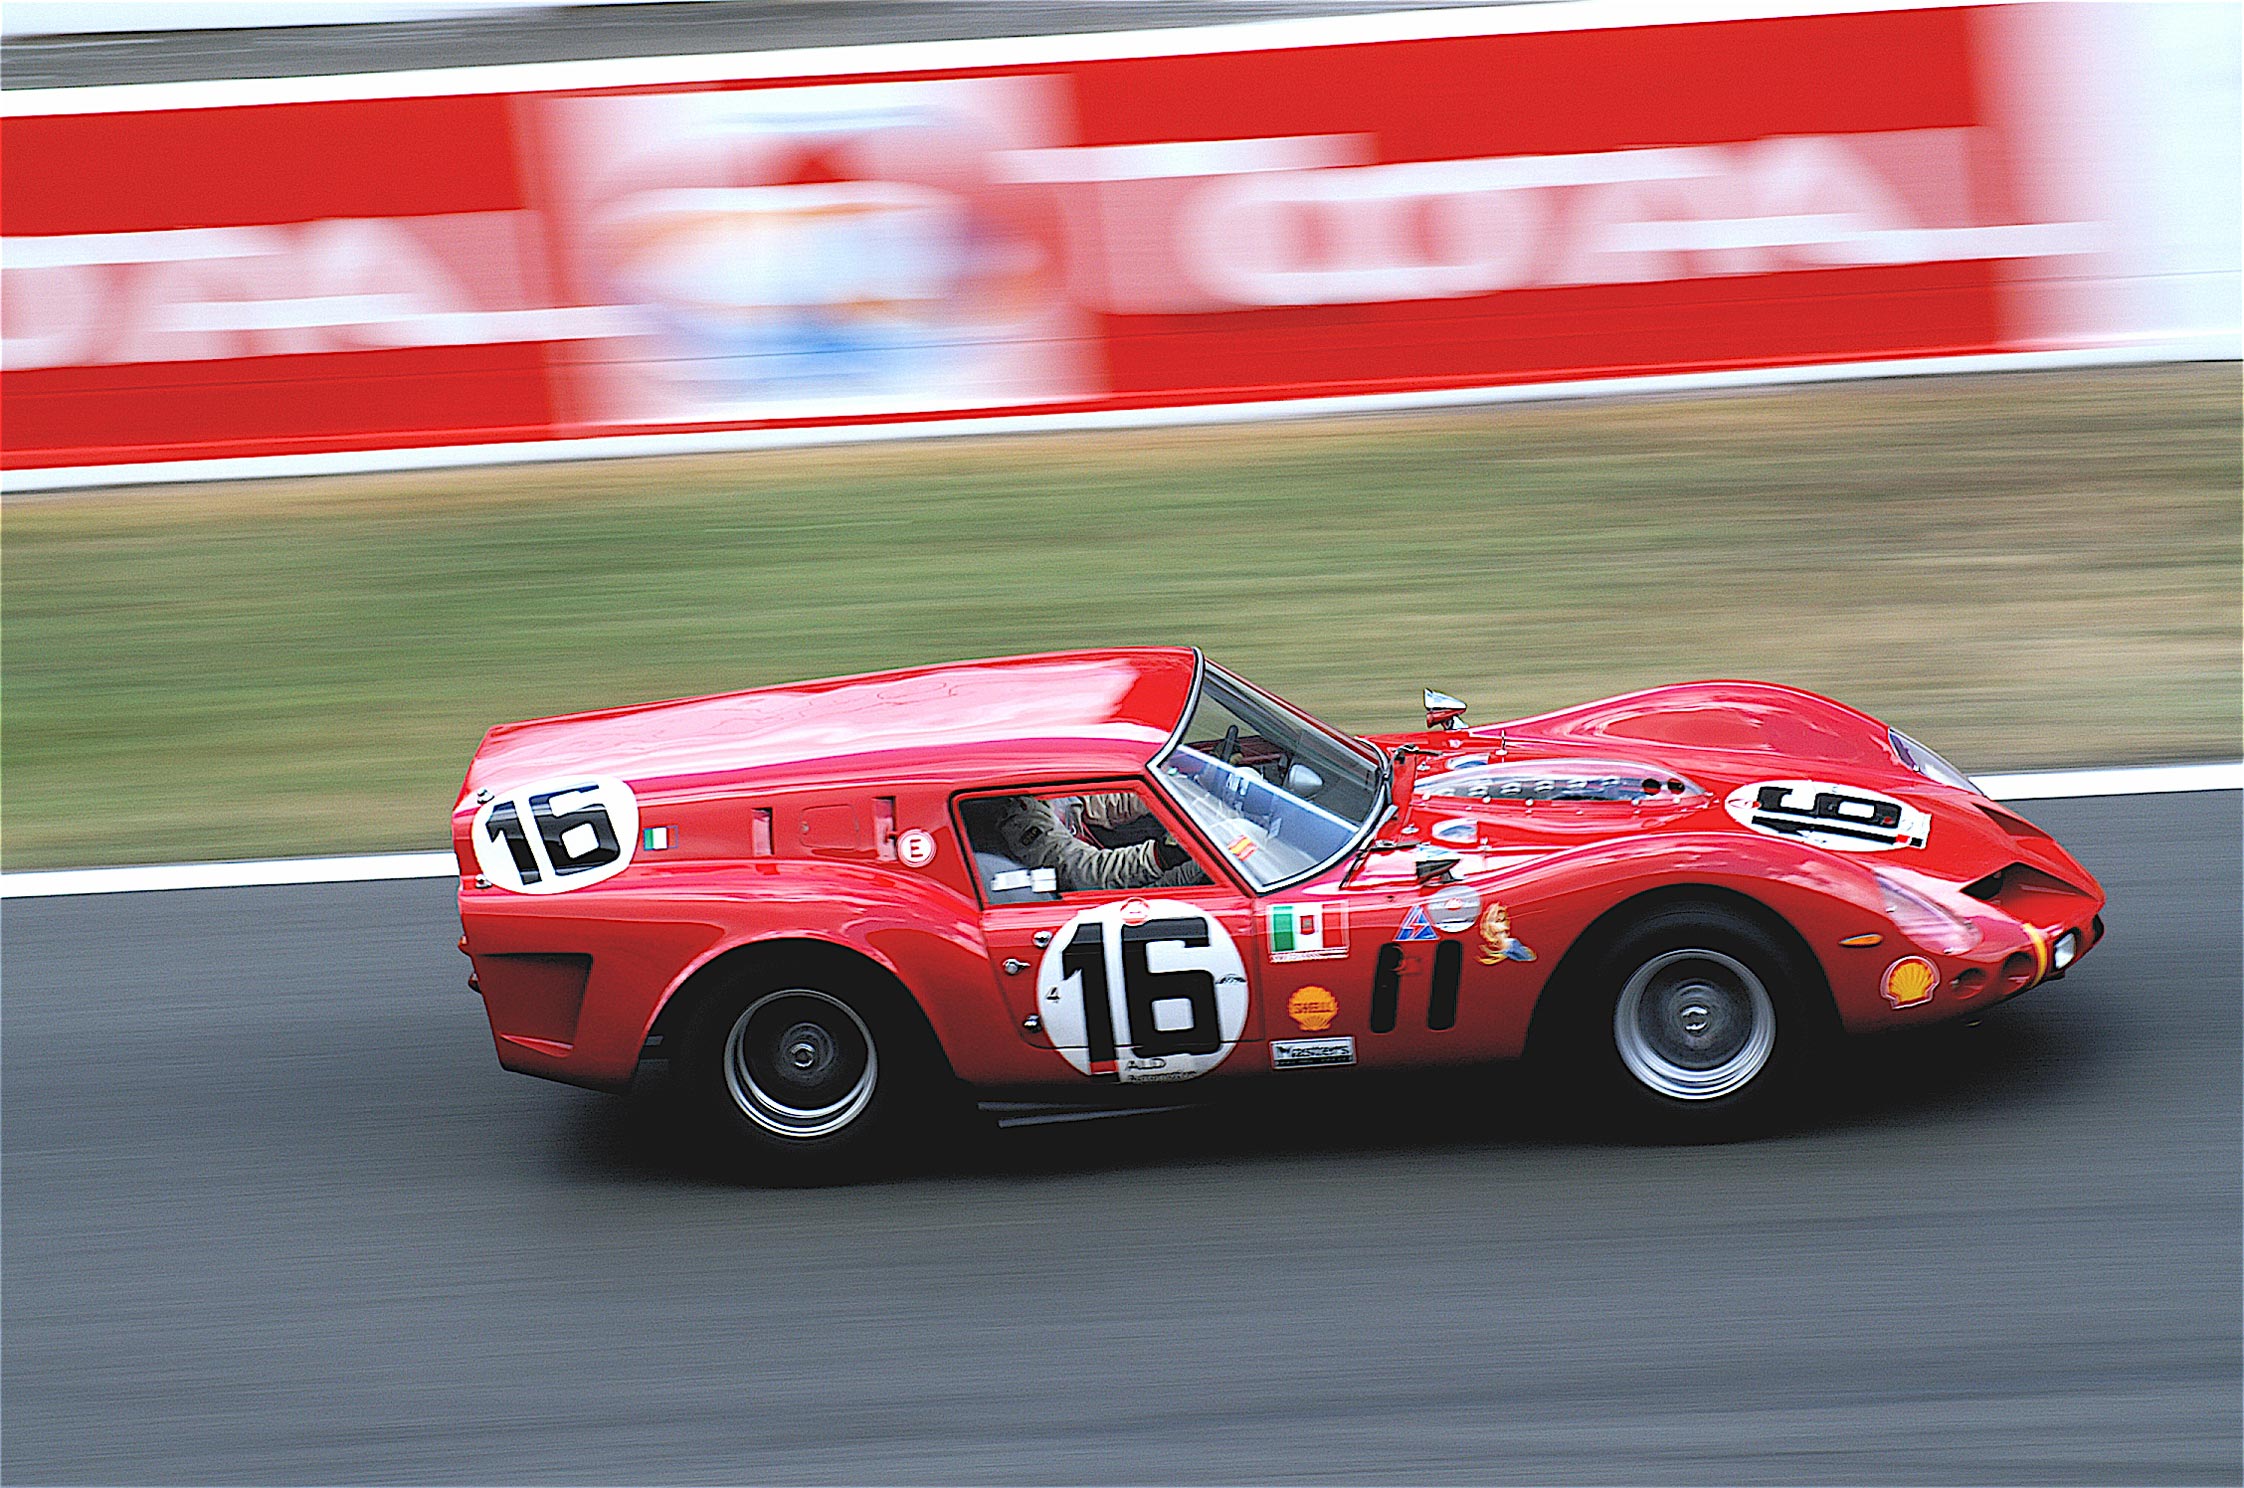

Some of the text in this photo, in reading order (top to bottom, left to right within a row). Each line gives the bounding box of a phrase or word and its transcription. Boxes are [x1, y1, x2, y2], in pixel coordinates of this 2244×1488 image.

[485, 780, 621, 885] 16
[909, 838, 924, 858] E
[1752, 786, 1922, 847] 16
[1060, 916, 1222, 1083] 16
